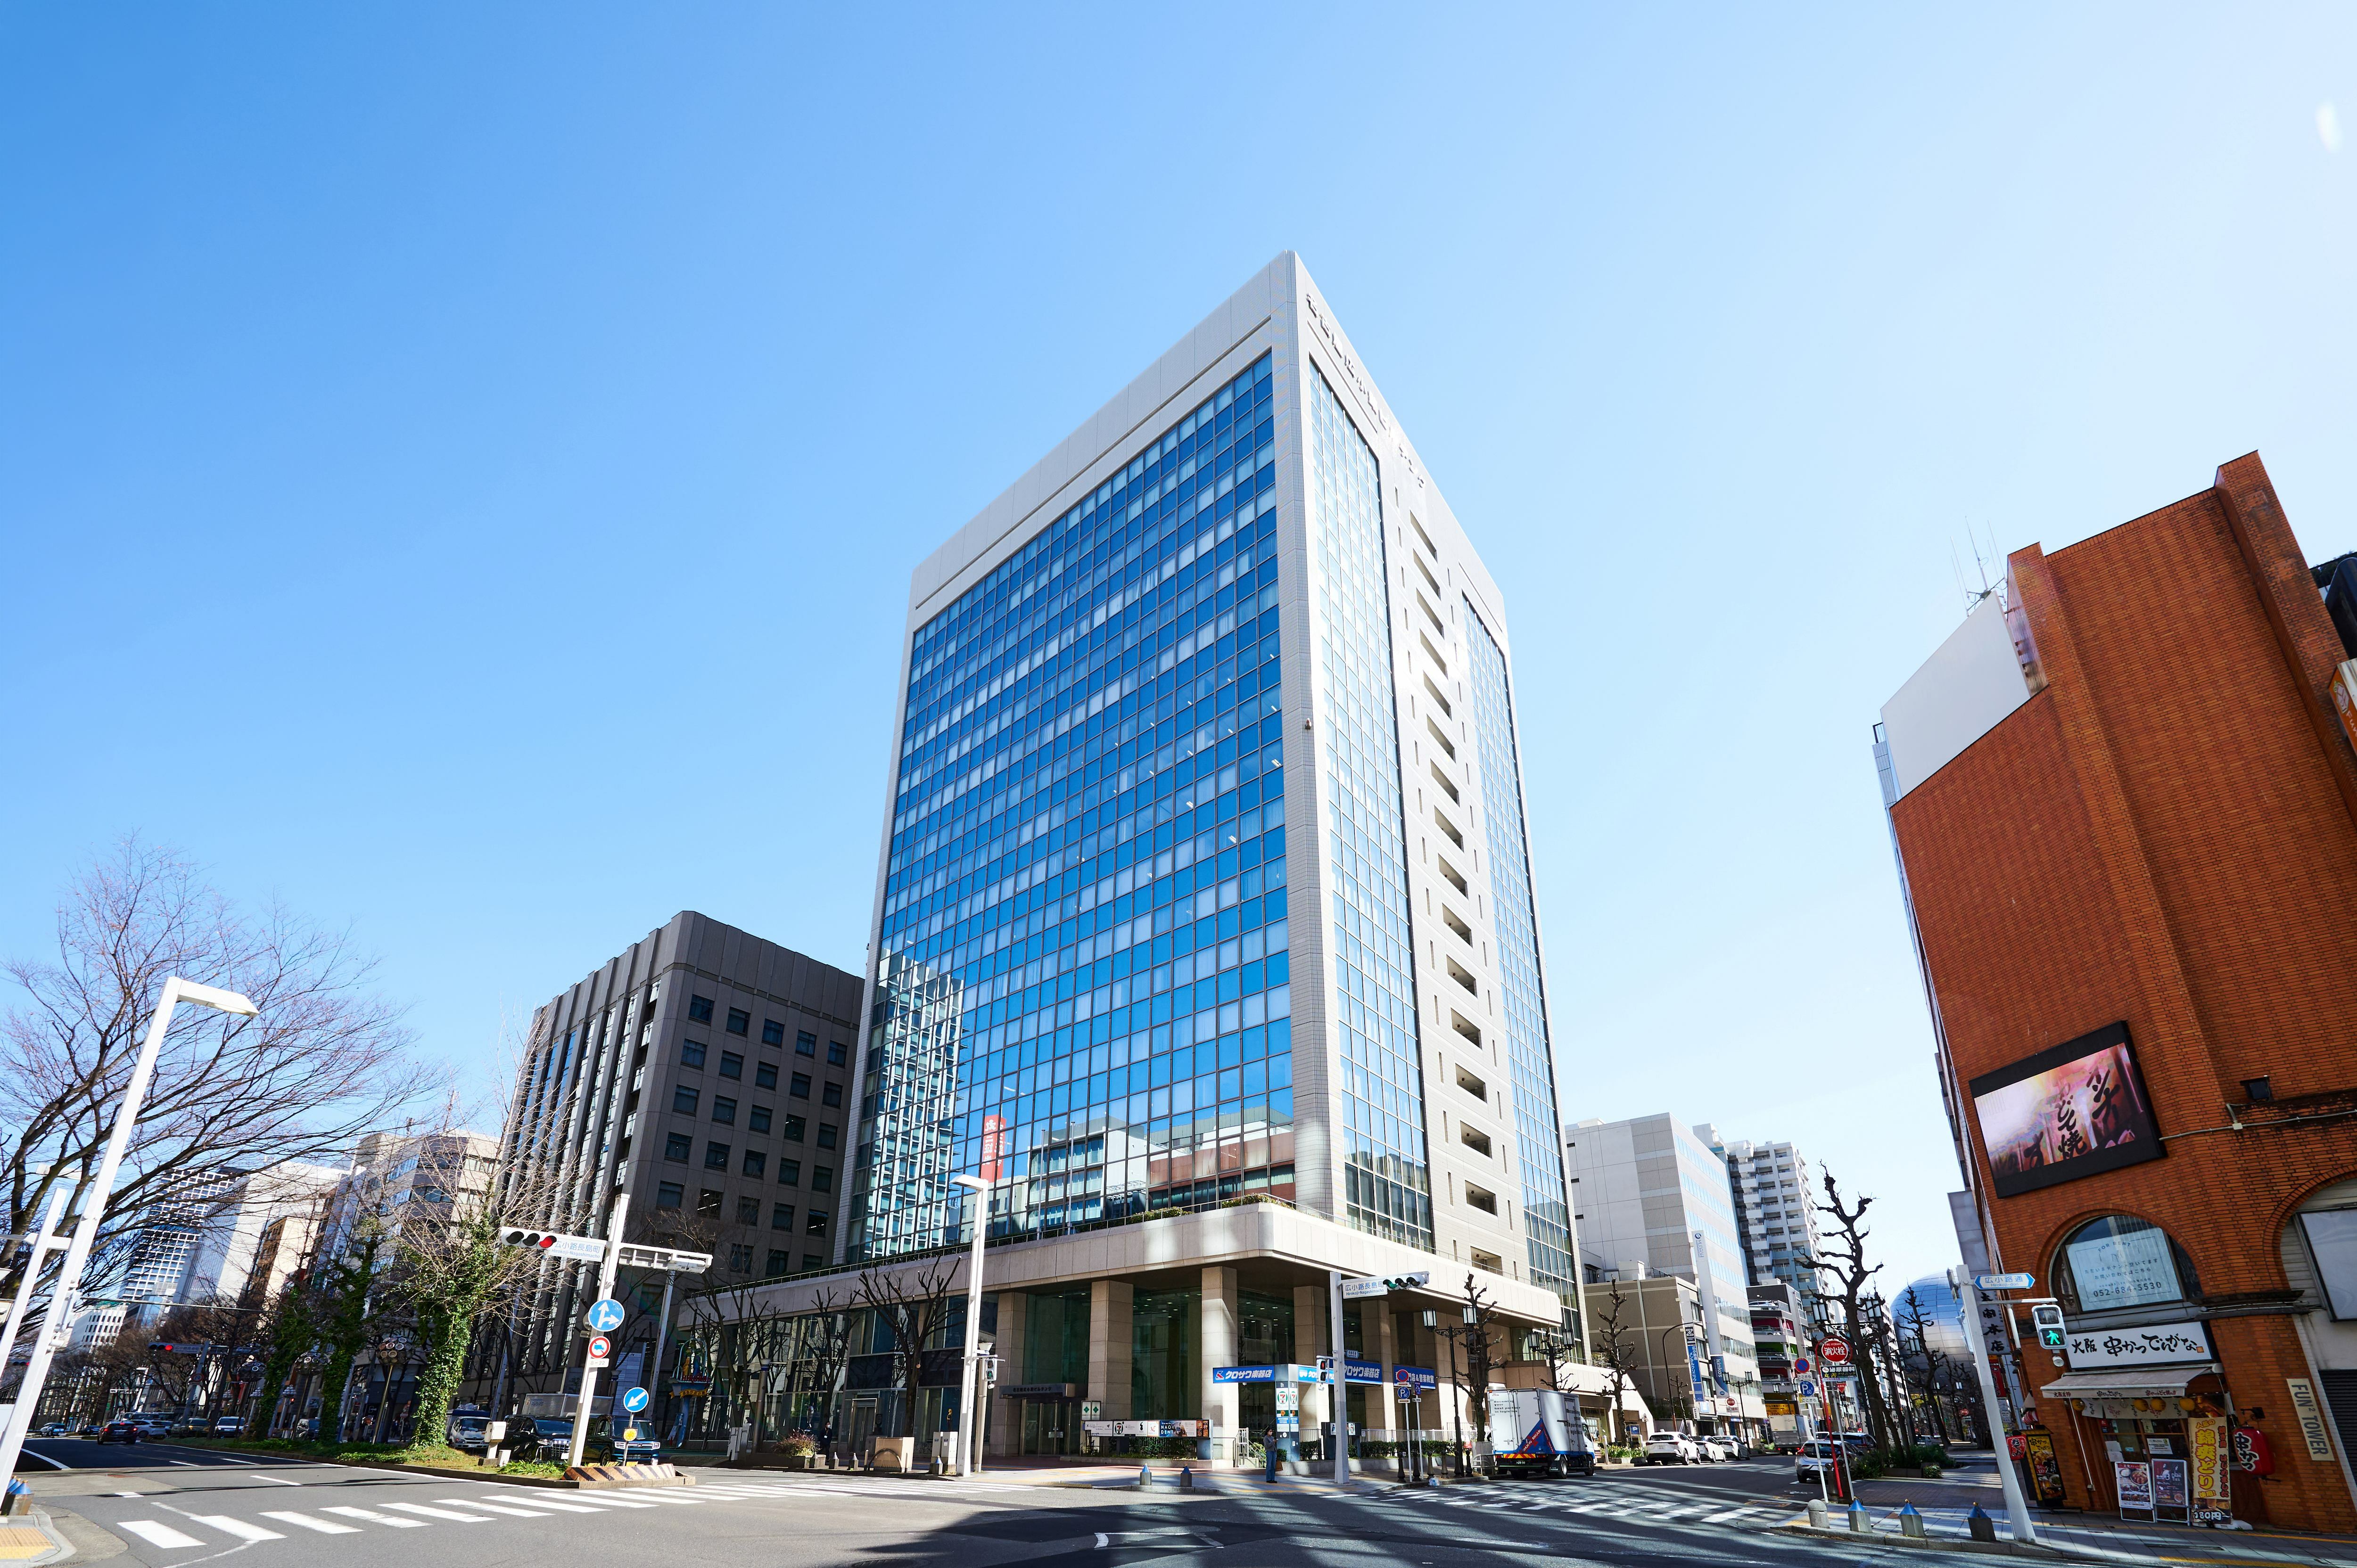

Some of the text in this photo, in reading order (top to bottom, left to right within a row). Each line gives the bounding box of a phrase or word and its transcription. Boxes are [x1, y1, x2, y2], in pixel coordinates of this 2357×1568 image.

[2098, 1243, 2110, 1252] FOR
[551, 1248, 600, 1259] Hirokoji-Nagashimacho
[1985, 1276, 2023, 1284] 広小路通
[1345, 1281, 1384, 1291] 広小路長島町
[2093, 1281, 2162, 1297] 052-684-5530
[2072, 1338, 2097, 1354] 大阪
[1824, 1347, 1846, 1356] 消火栓
[1226, 1370, 1272, 1379] クロサワ楽器店
[1400, 1389, 1405, 1397] P
[1802, 1385, 1808, 1394] P
[2302, 1415, 2328, 1455] TOWER
[2235, 1432, 2259, 1470] 串かつ
